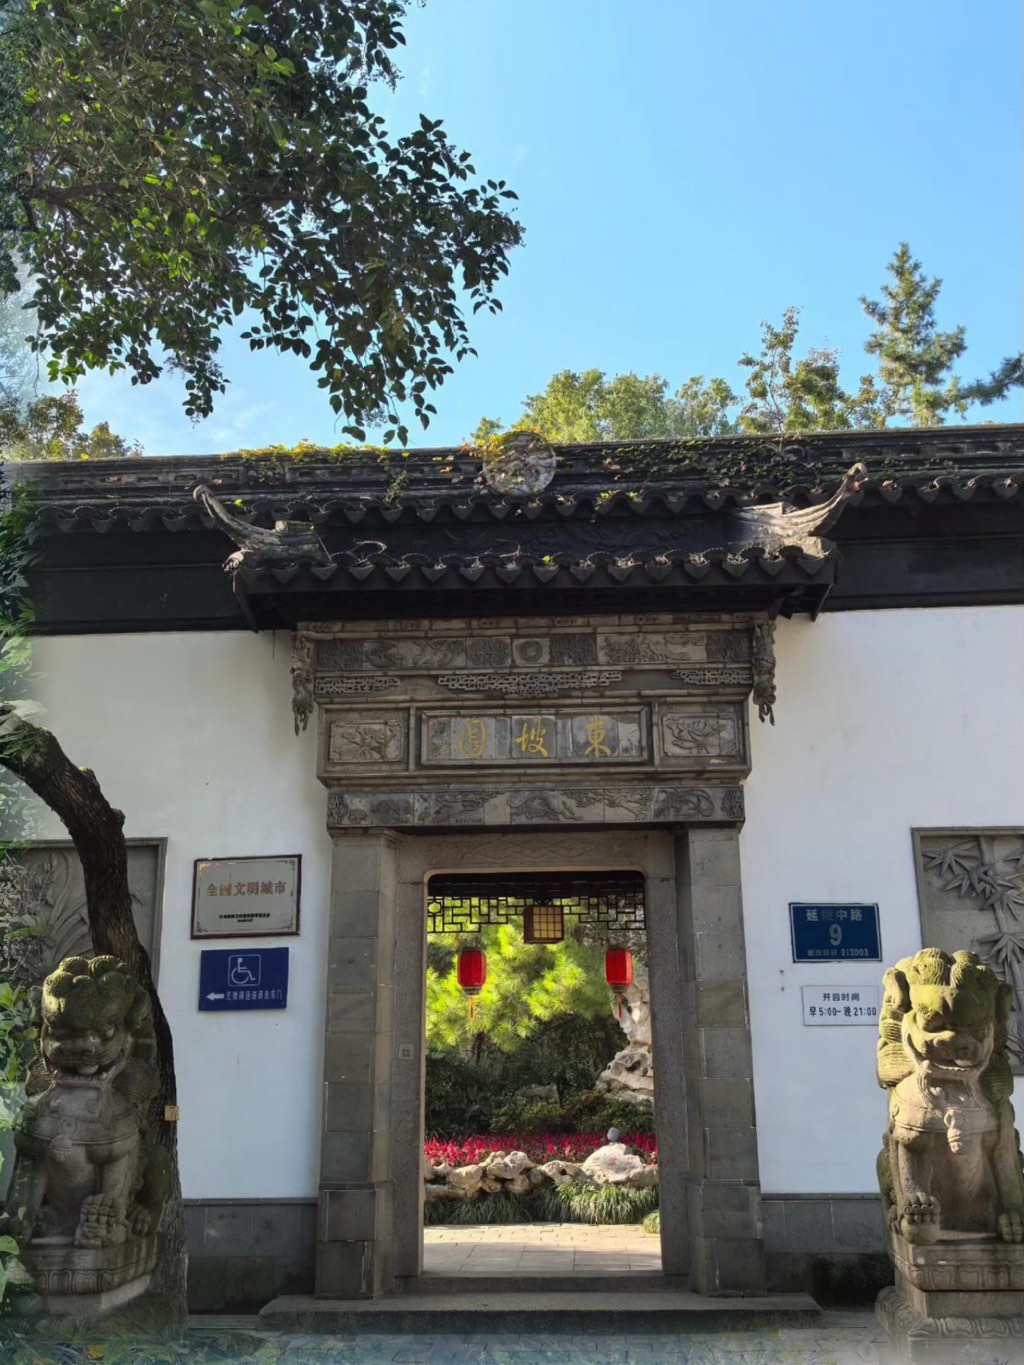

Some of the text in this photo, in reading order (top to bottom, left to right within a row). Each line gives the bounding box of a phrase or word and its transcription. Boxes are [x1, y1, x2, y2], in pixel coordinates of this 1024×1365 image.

[206, 880, 287, 897] 全国文明城市
[829, 923, 842, 946] 9
[822, 992, 860, 1002] 开园时间
